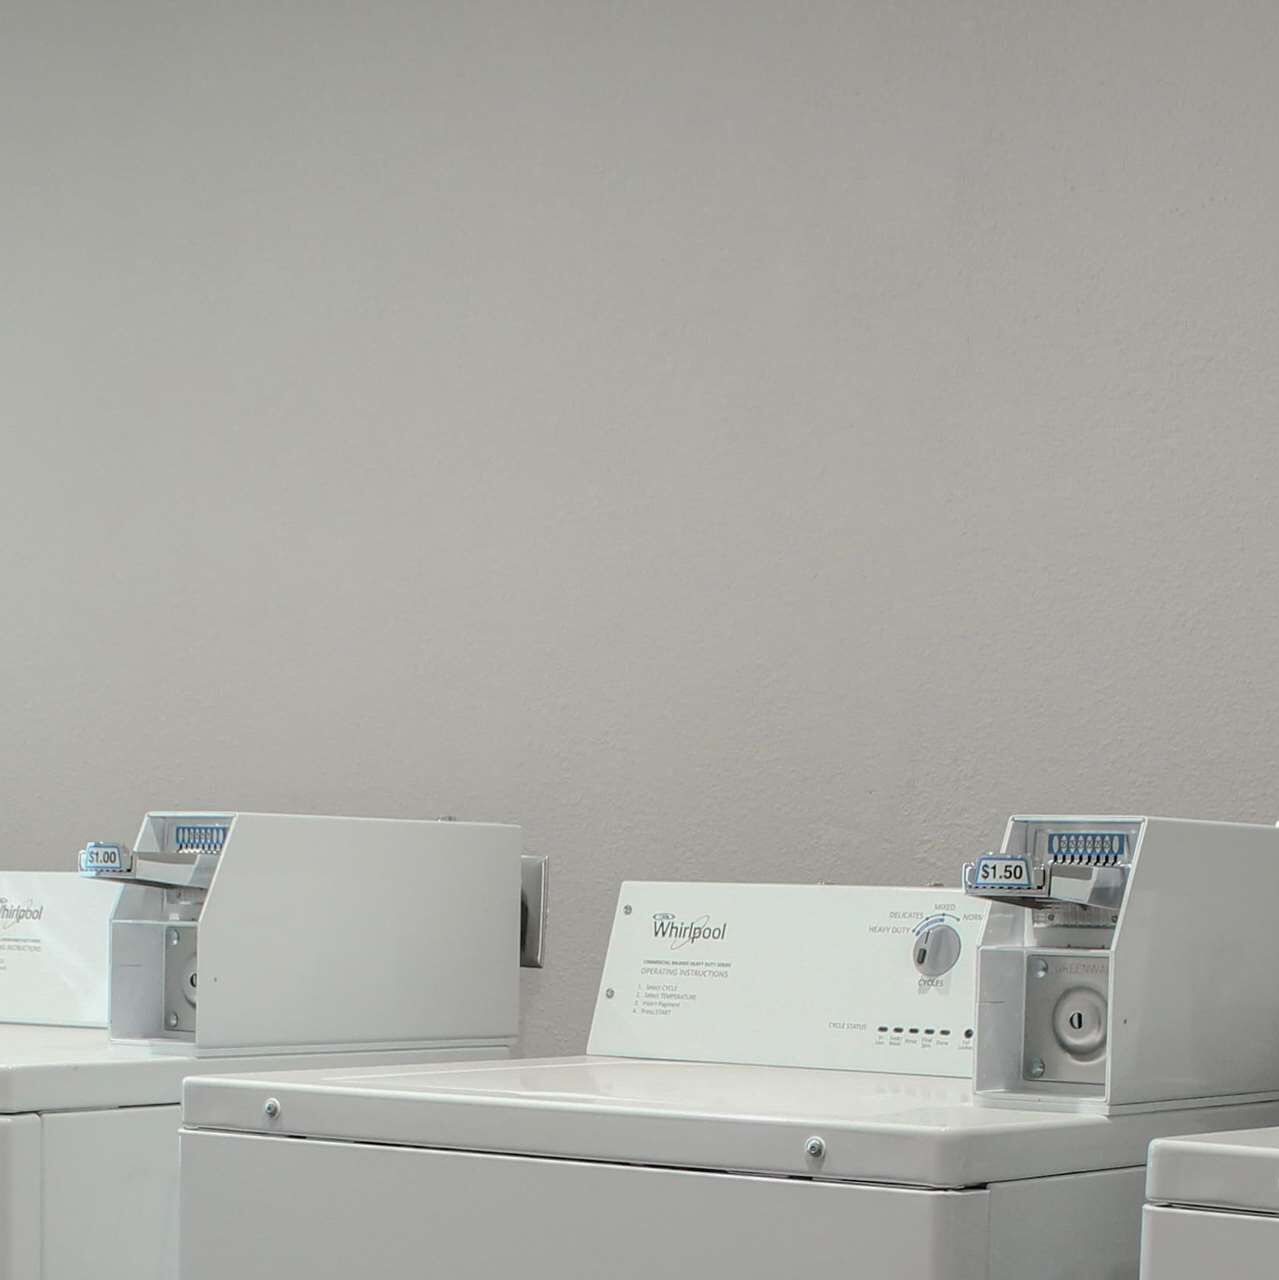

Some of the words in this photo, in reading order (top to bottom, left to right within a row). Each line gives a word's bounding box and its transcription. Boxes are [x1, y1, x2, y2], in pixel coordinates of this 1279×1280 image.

[88, 850, 117, 864] $1.00
[981, 864, 1023, 880] $1.50
[653, 921, 727, 944] Whirlpool
[918, 977, 944, 988] CYCLES
